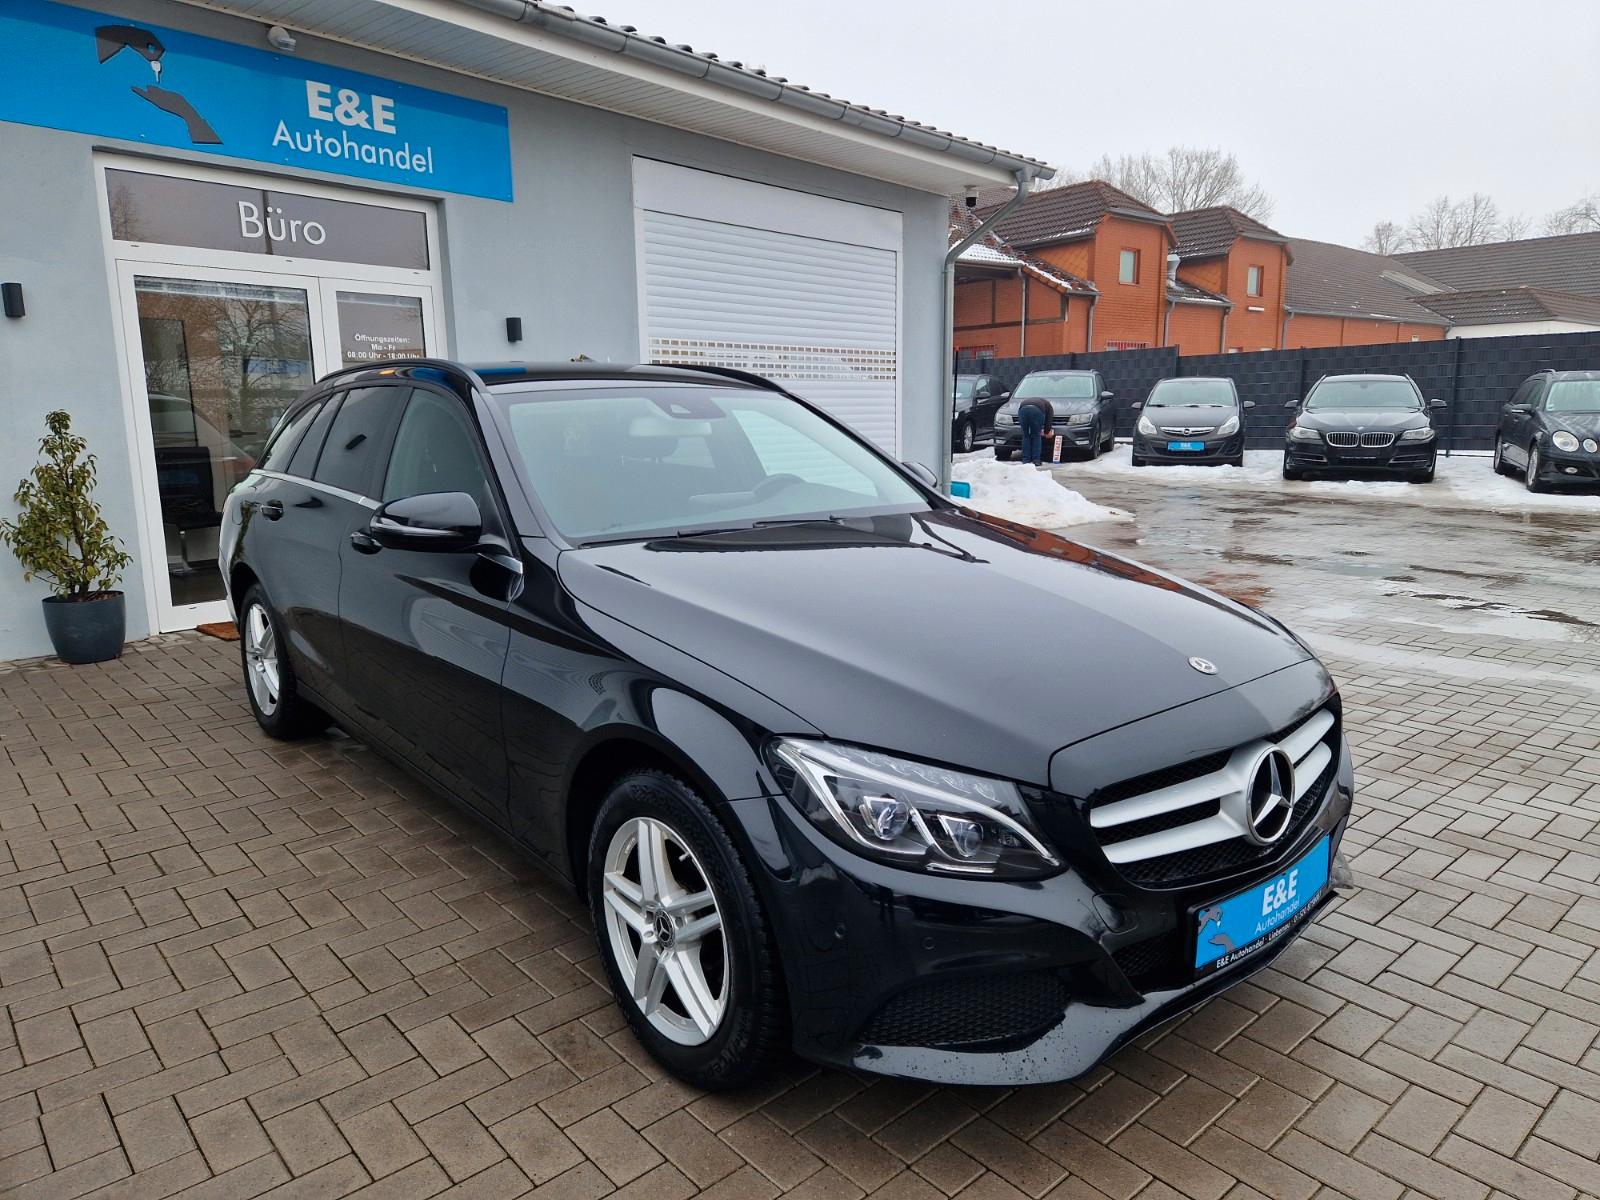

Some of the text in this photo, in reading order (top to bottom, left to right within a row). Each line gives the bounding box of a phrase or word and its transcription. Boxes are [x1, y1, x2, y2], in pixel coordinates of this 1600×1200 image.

[306, 80, 396, 134] E&E
[272, 120, 433, 173] Autohandel
[238, 200, 326, 245] Büro
[354, 332, 411, 343] Öffnungszeiten:
[1254, 896, 1300, 935] Autohandel
[1262, 869, 1299, 917] E&E
[1216, 955, 1230, 969] E&E
[1230, 937, 1265, 962] Autohandel
